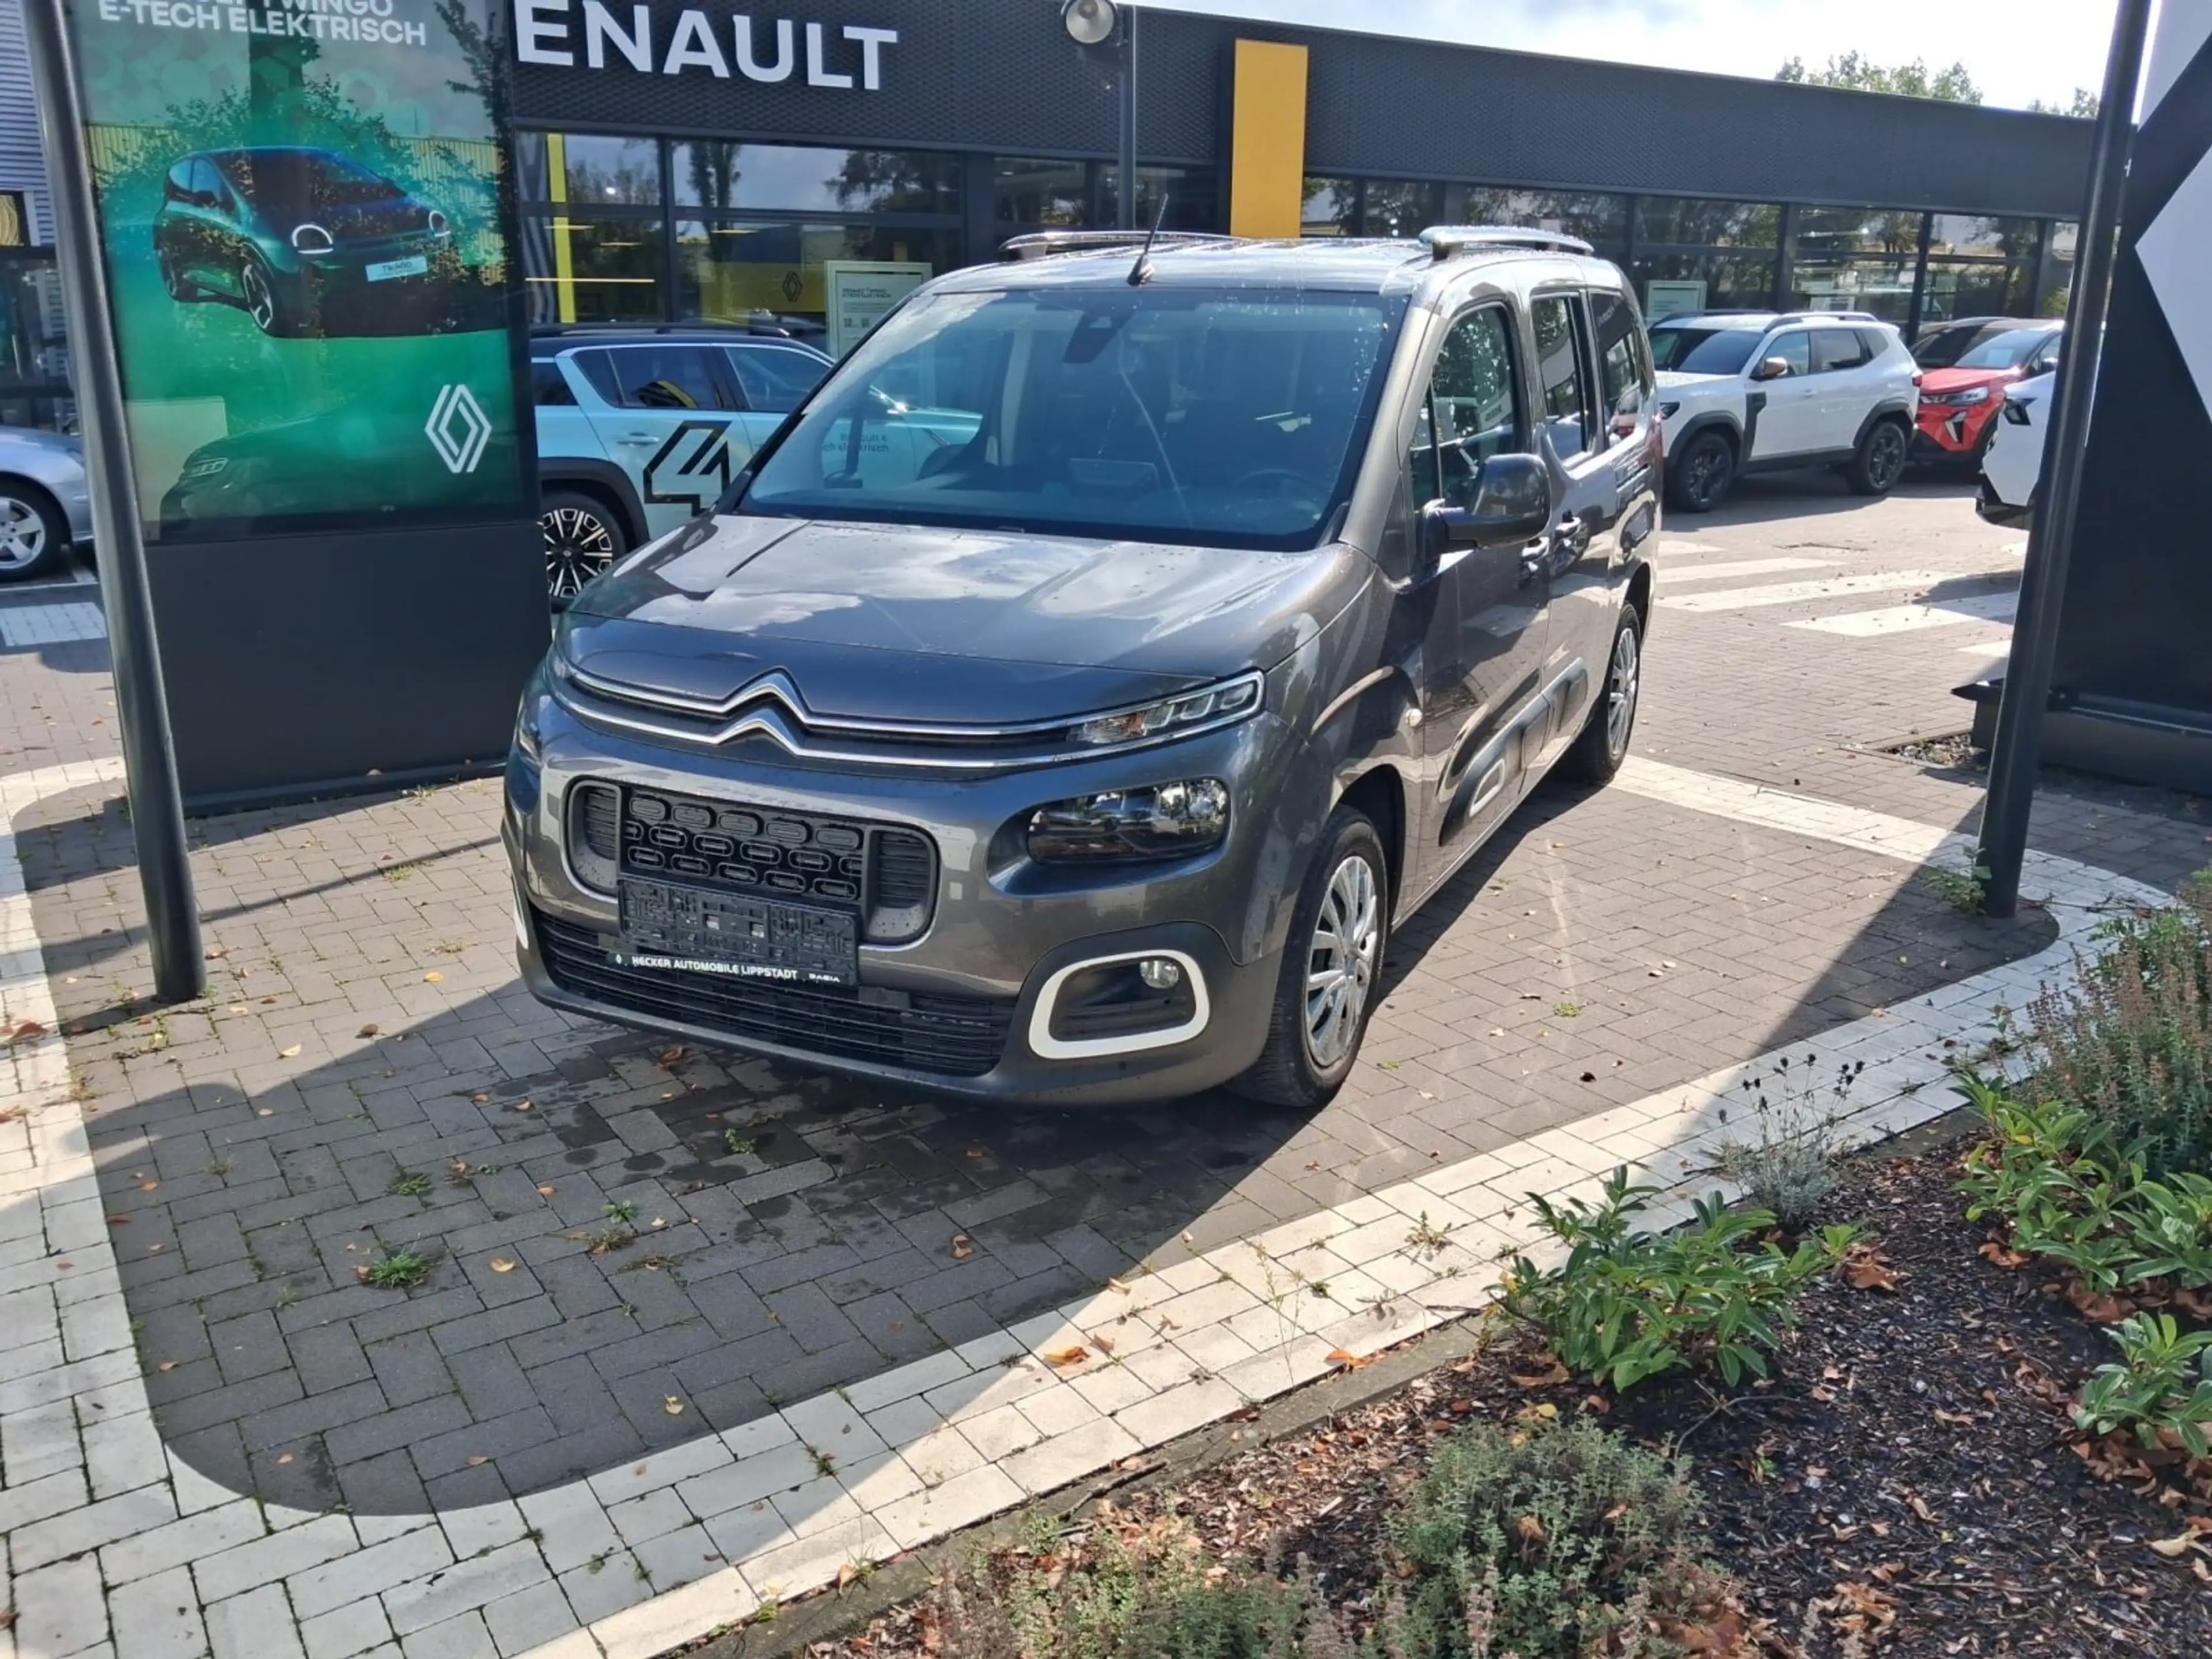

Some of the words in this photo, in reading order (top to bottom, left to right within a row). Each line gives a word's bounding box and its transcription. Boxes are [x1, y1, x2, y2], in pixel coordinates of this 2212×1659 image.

[98, 0, 221, 30] E-TECH
[228, 7, 426, 46] ELEKTRISCH
[514, 0, 898, 90] ENAULT
[632, 956, 671, 968] HECKER
[673, 960, 739, 974] AUTOMOBILE
[741, 965, 798, 980] LIPPSTADT
